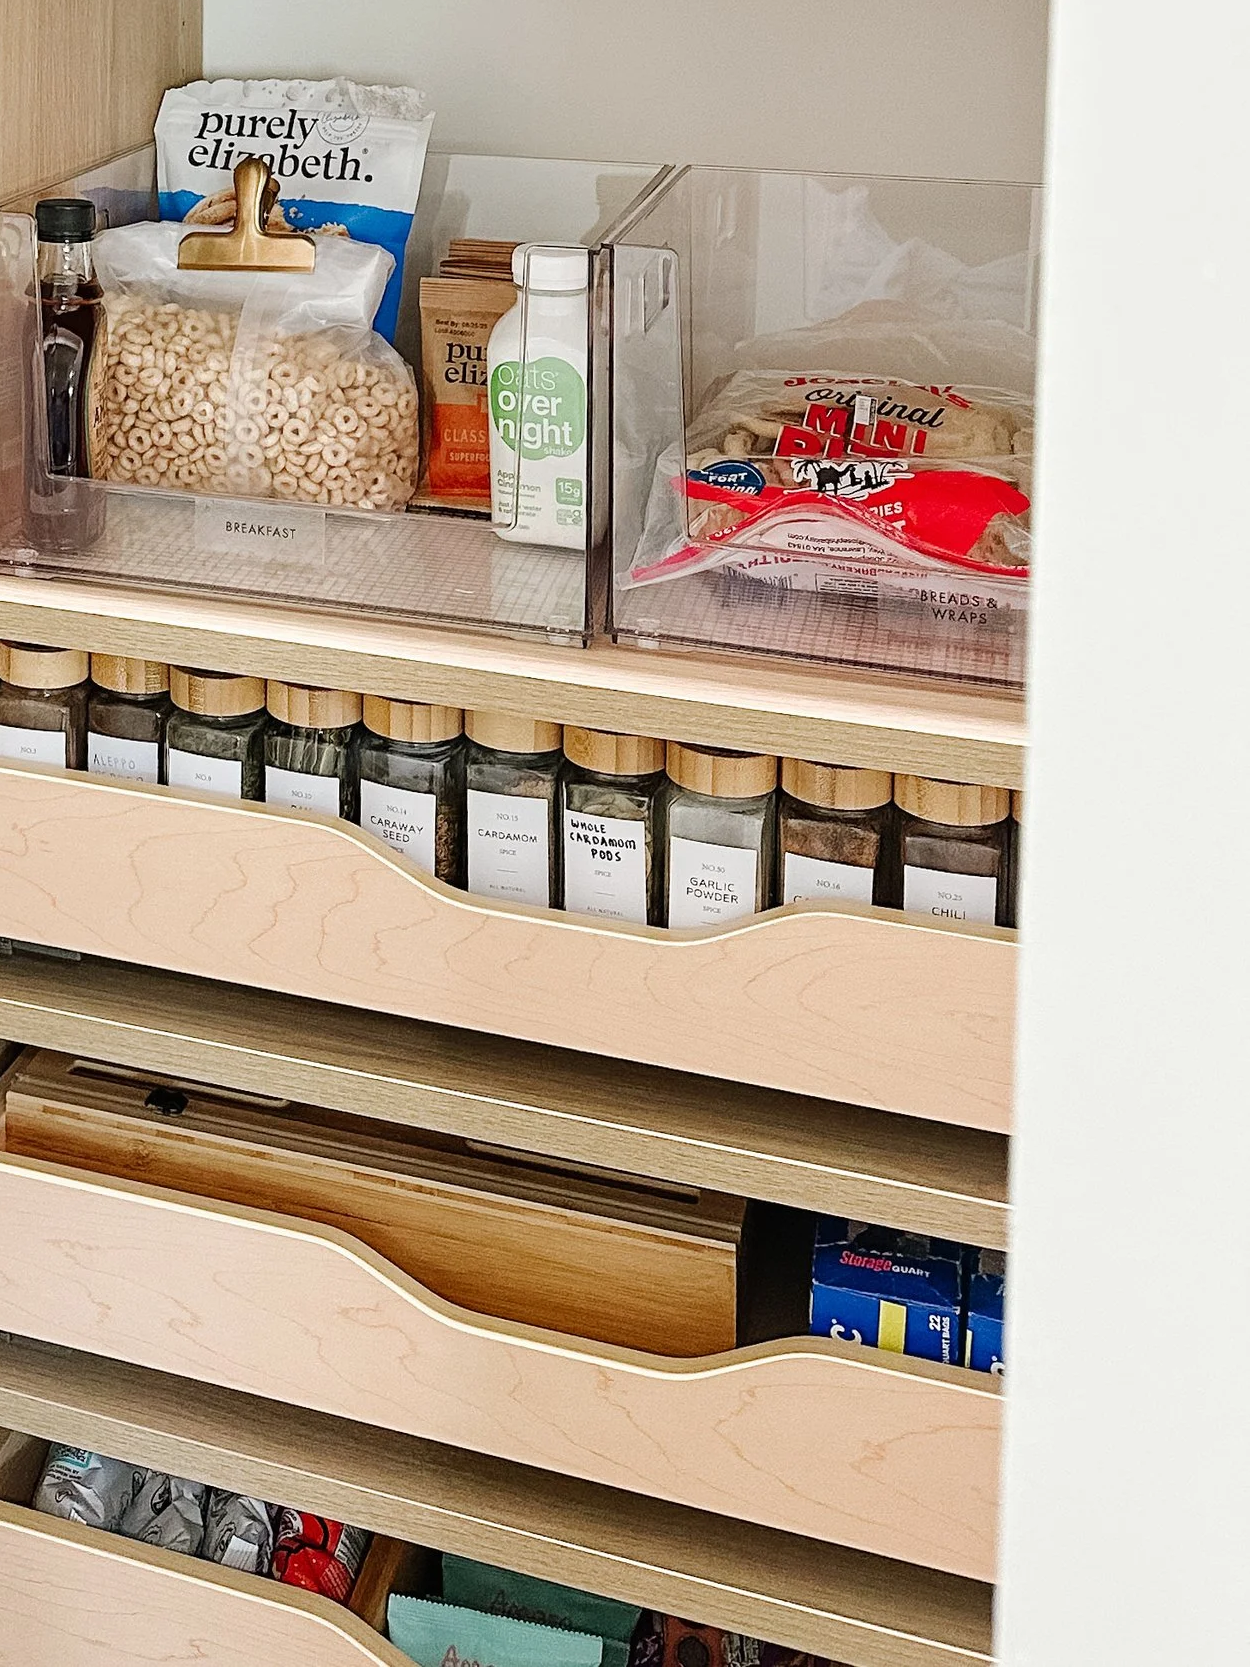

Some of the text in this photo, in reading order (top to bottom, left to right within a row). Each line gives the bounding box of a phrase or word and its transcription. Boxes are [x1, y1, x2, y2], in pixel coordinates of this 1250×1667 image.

[194, 108, 320, 149] purely
[497, 364, 556, 391] Oats
[497, 390, 562, 416] over
[499, 418, 573, 450] nght
[803, 403, 928, 455] MINI
[557, 481, 581, 498] 15g
[225, 521, 297, 539] BREAKFAST
[920, 589, 998, 609] BREADS &
[932, 608, 988, 625] WRAPS
[93, 753, 136, 771] ALEPPO
[370, 815, 425, 834] CARAWAY
[570, 818, 606, 834] WHOLE
[382, 829, 410, 843] SEED
[477, 828, 538, 843] CARDAMOM
[569, 831, 637, 851] CARDAMOM
[590, 848, 622, 862] PODS
[689, 876, 735, 893] GARLIC
[686, 887, 739, 905] POWDER
[839, 1250, 931, 1279] Storage QUART
[928, 1314, 942, 1331] 22
